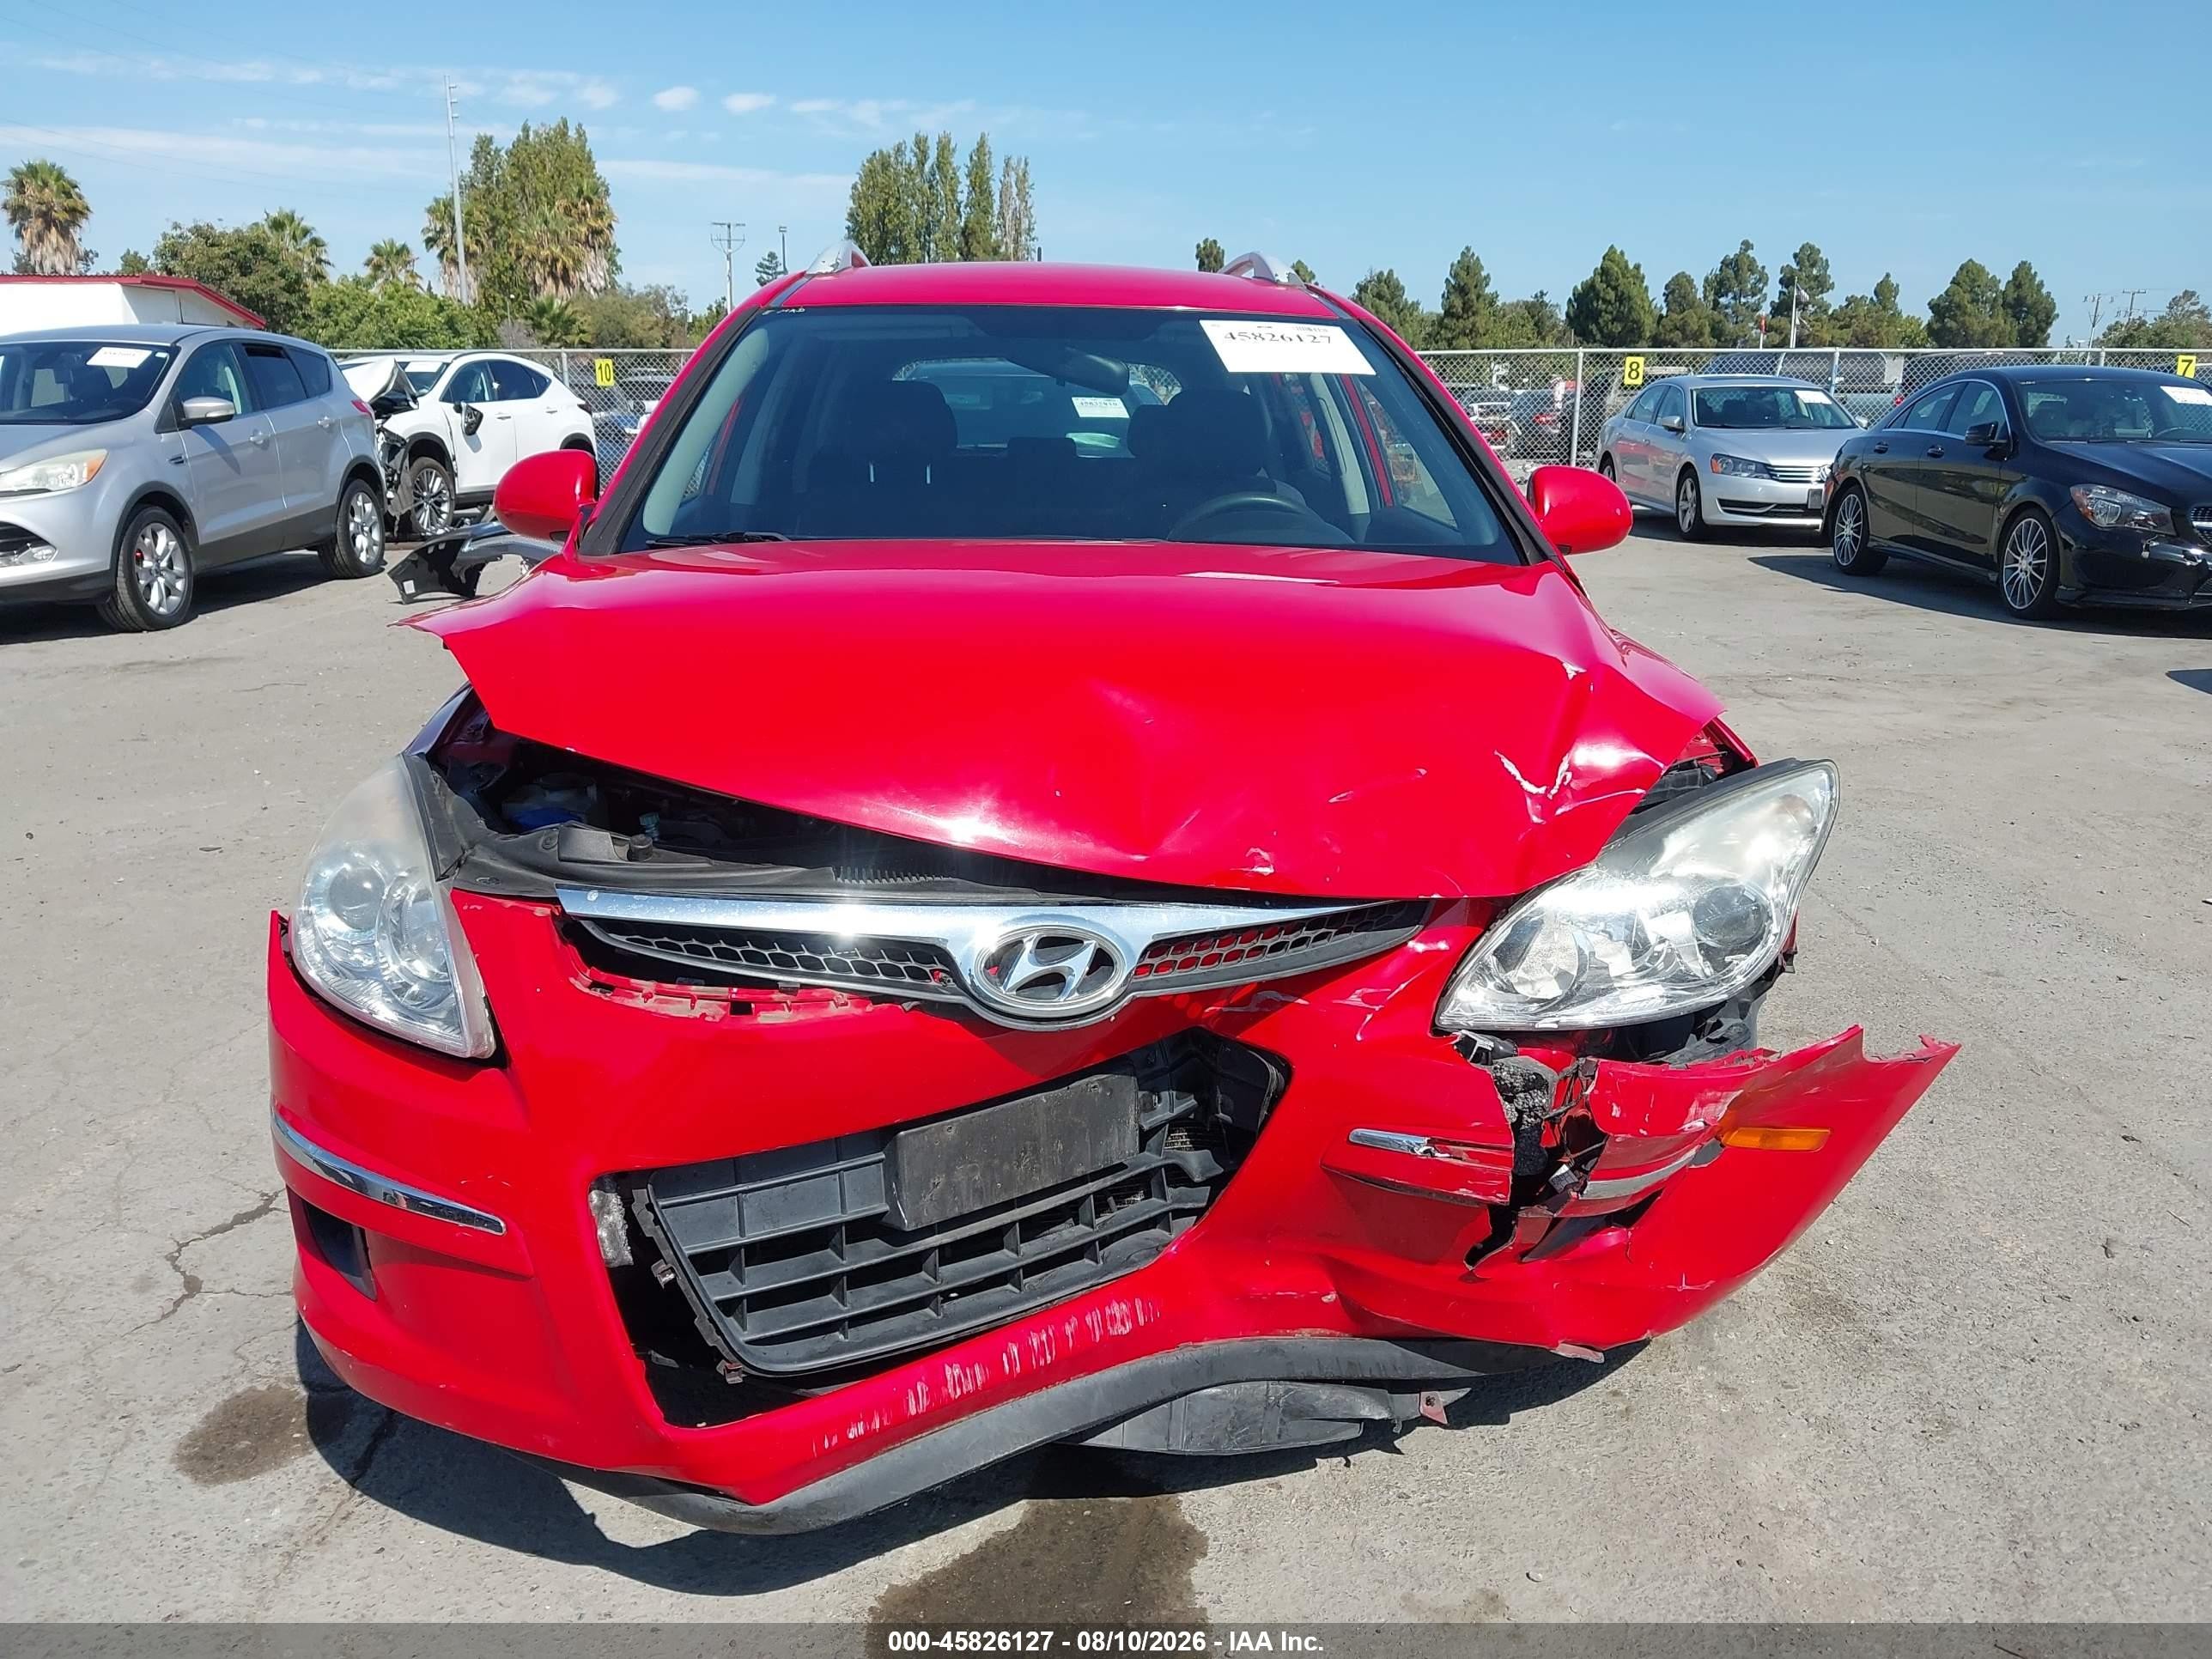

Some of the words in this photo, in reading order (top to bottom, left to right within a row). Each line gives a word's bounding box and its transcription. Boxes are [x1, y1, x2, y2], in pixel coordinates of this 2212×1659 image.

[1224, 331, 1331, 344] 45826127
[599, 363, 611, 382] 10
[1628, 362, 1639, 380] 8
[2181, 359, 2193, 376] 7
